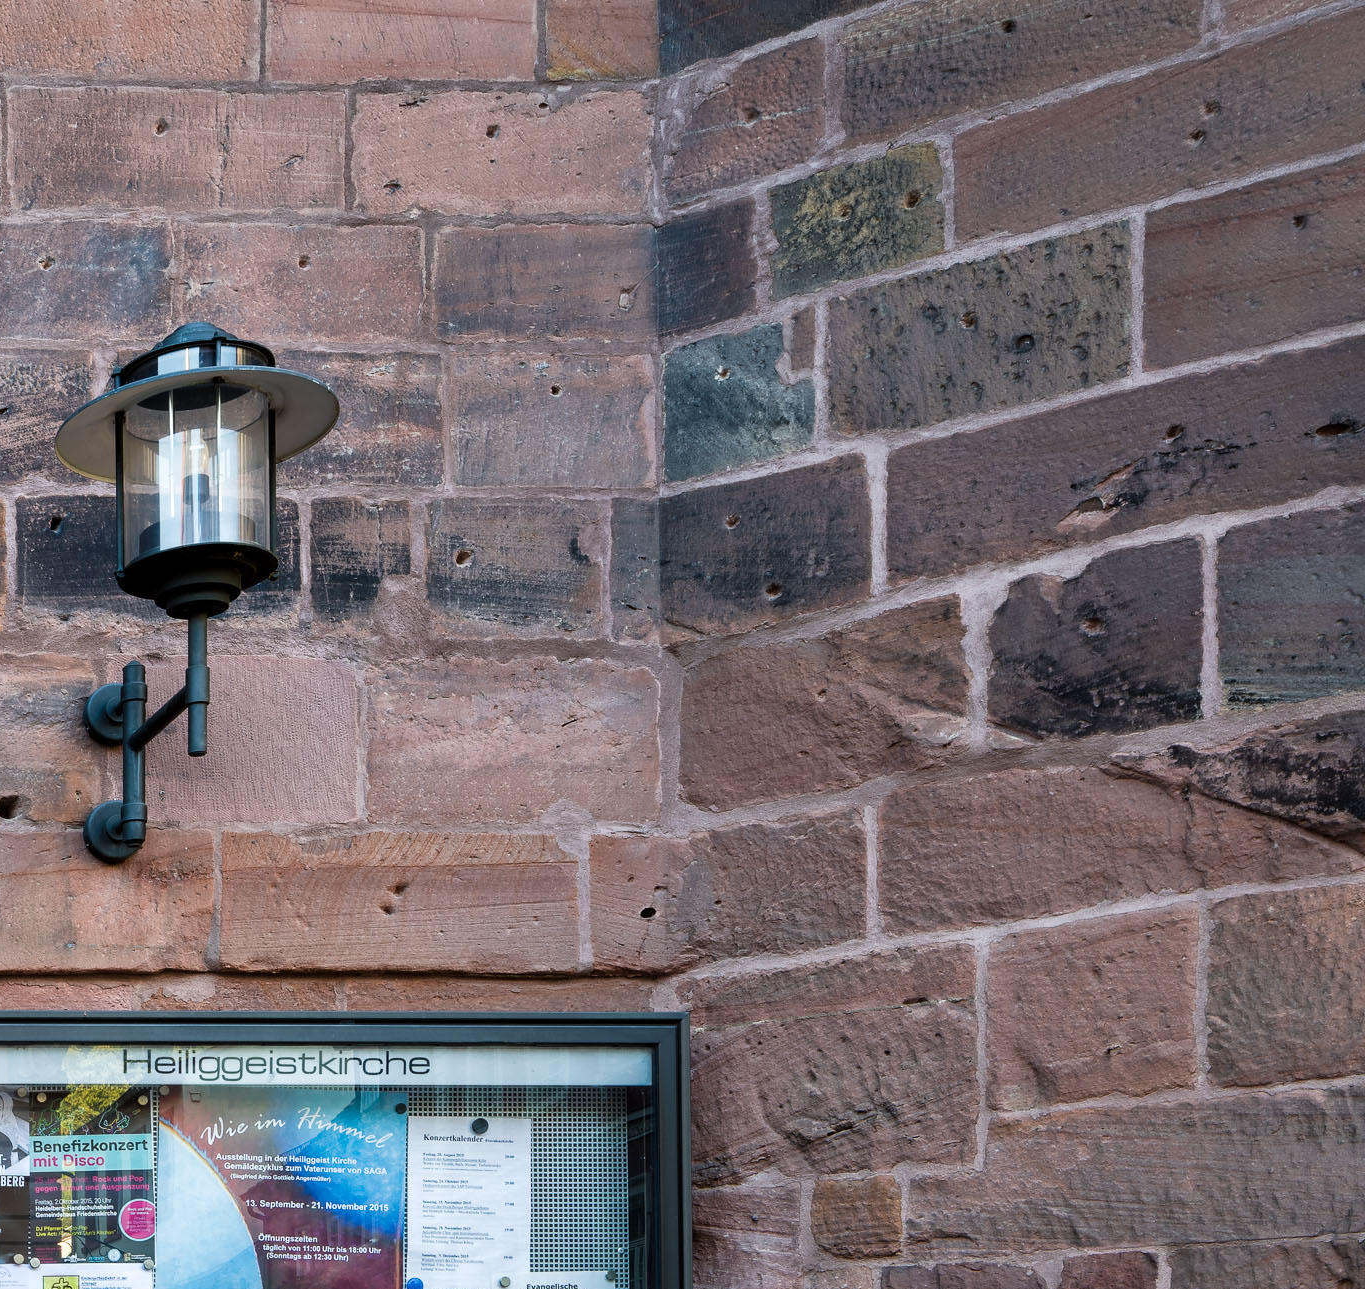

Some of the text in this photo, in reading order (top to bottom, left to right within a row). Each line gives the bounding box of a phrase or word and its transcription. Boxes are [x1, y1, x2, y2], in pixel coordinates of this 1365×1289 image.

[123, 1050, 430, 1081] Heiliggeistkirche
[200, 1106, 394, 1148] Wie im Himmel
[423, 1134, 483, 1143] Konzertkalender
[33, 1139, 148, 1153] Benefizkonzert
[33, 1154, 105, 1167] mit Disco
[216, 1153, 357, 1165] Ausstellung in der Heiliggeist Kirche
[224, 1162, 283, 1171] Gemäldezyklus
[304, 1165, 345, 1173] Vaterunser
[364, 1167, 387, 1175] SAGA
[129, 1175, 144, 1183] Pop
[230, 1173, 257, 1181] (Siegfried
[296, 1175, 331, 1183] Angermüller)
[101, 1183, 150, 1192] Ausgrenzung
[246, 1200, 257, 1208] 13.
[260, 1200, 304, 1210] September
[325, 1202, 367, 1211] November
[369, 1204, 389, 1212] 2015
[258, 1233, 317, 1243] Öffnungszeiten
[263, 1244, 286, 1252] täglich
[267, 1252, 302, 1260] (Sonntags
